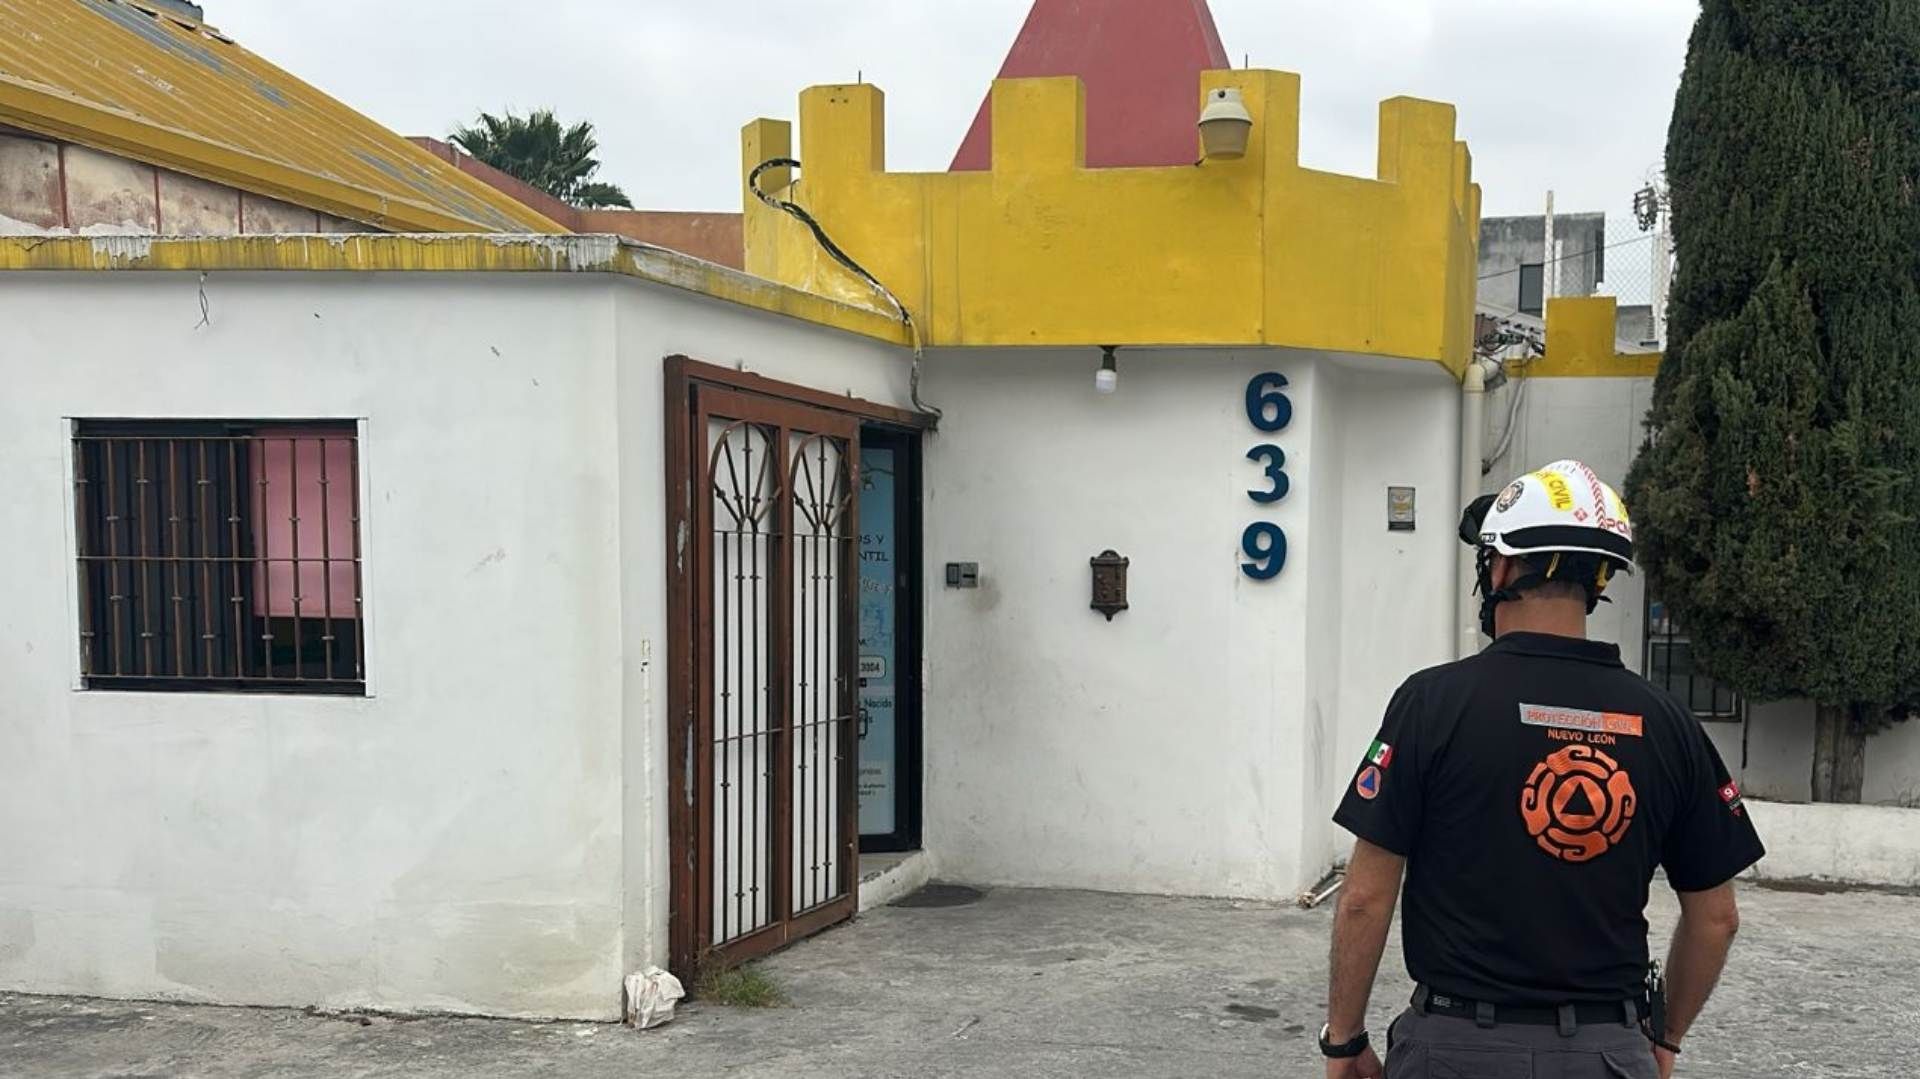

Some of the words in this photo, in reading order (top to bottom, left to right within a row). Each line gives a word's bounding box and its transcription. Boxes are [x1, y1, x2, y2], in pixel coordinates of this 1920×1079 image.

[1241, 372, 1292, 580] 639
[1548, 479, 1571, 509] CIVIL
[1547, 728, 1584, 742] NUEVO
[1587, 732, 1616, 745] LEÓN
